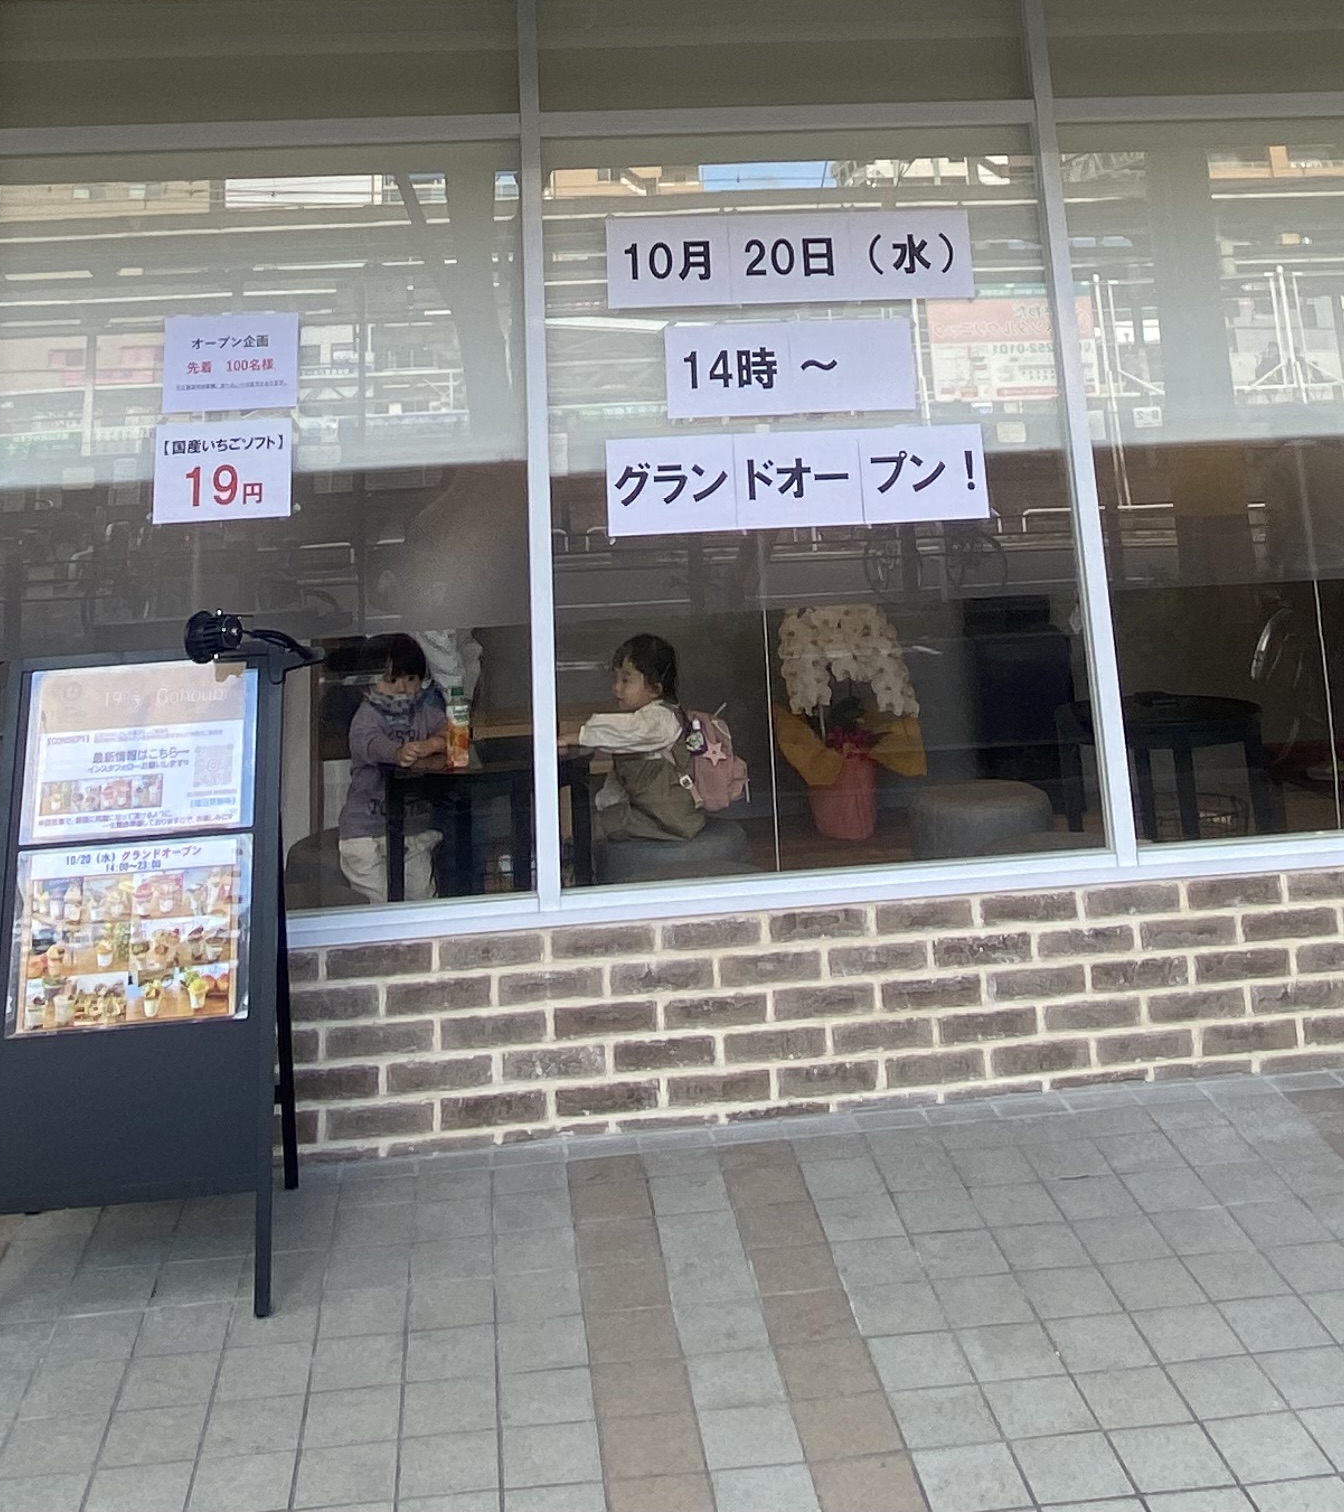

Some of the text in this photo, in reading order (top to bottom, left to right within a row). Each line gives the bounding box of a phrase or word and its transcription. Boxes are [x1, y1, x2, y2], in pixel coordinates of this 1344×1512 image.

[191, 335, 271, 351] オープン企画
[187, 361, 213, 376] 先着
[164, 434, 285, 457] 【国産いちごソフト】
[185, 464, 264, 508] 19円
